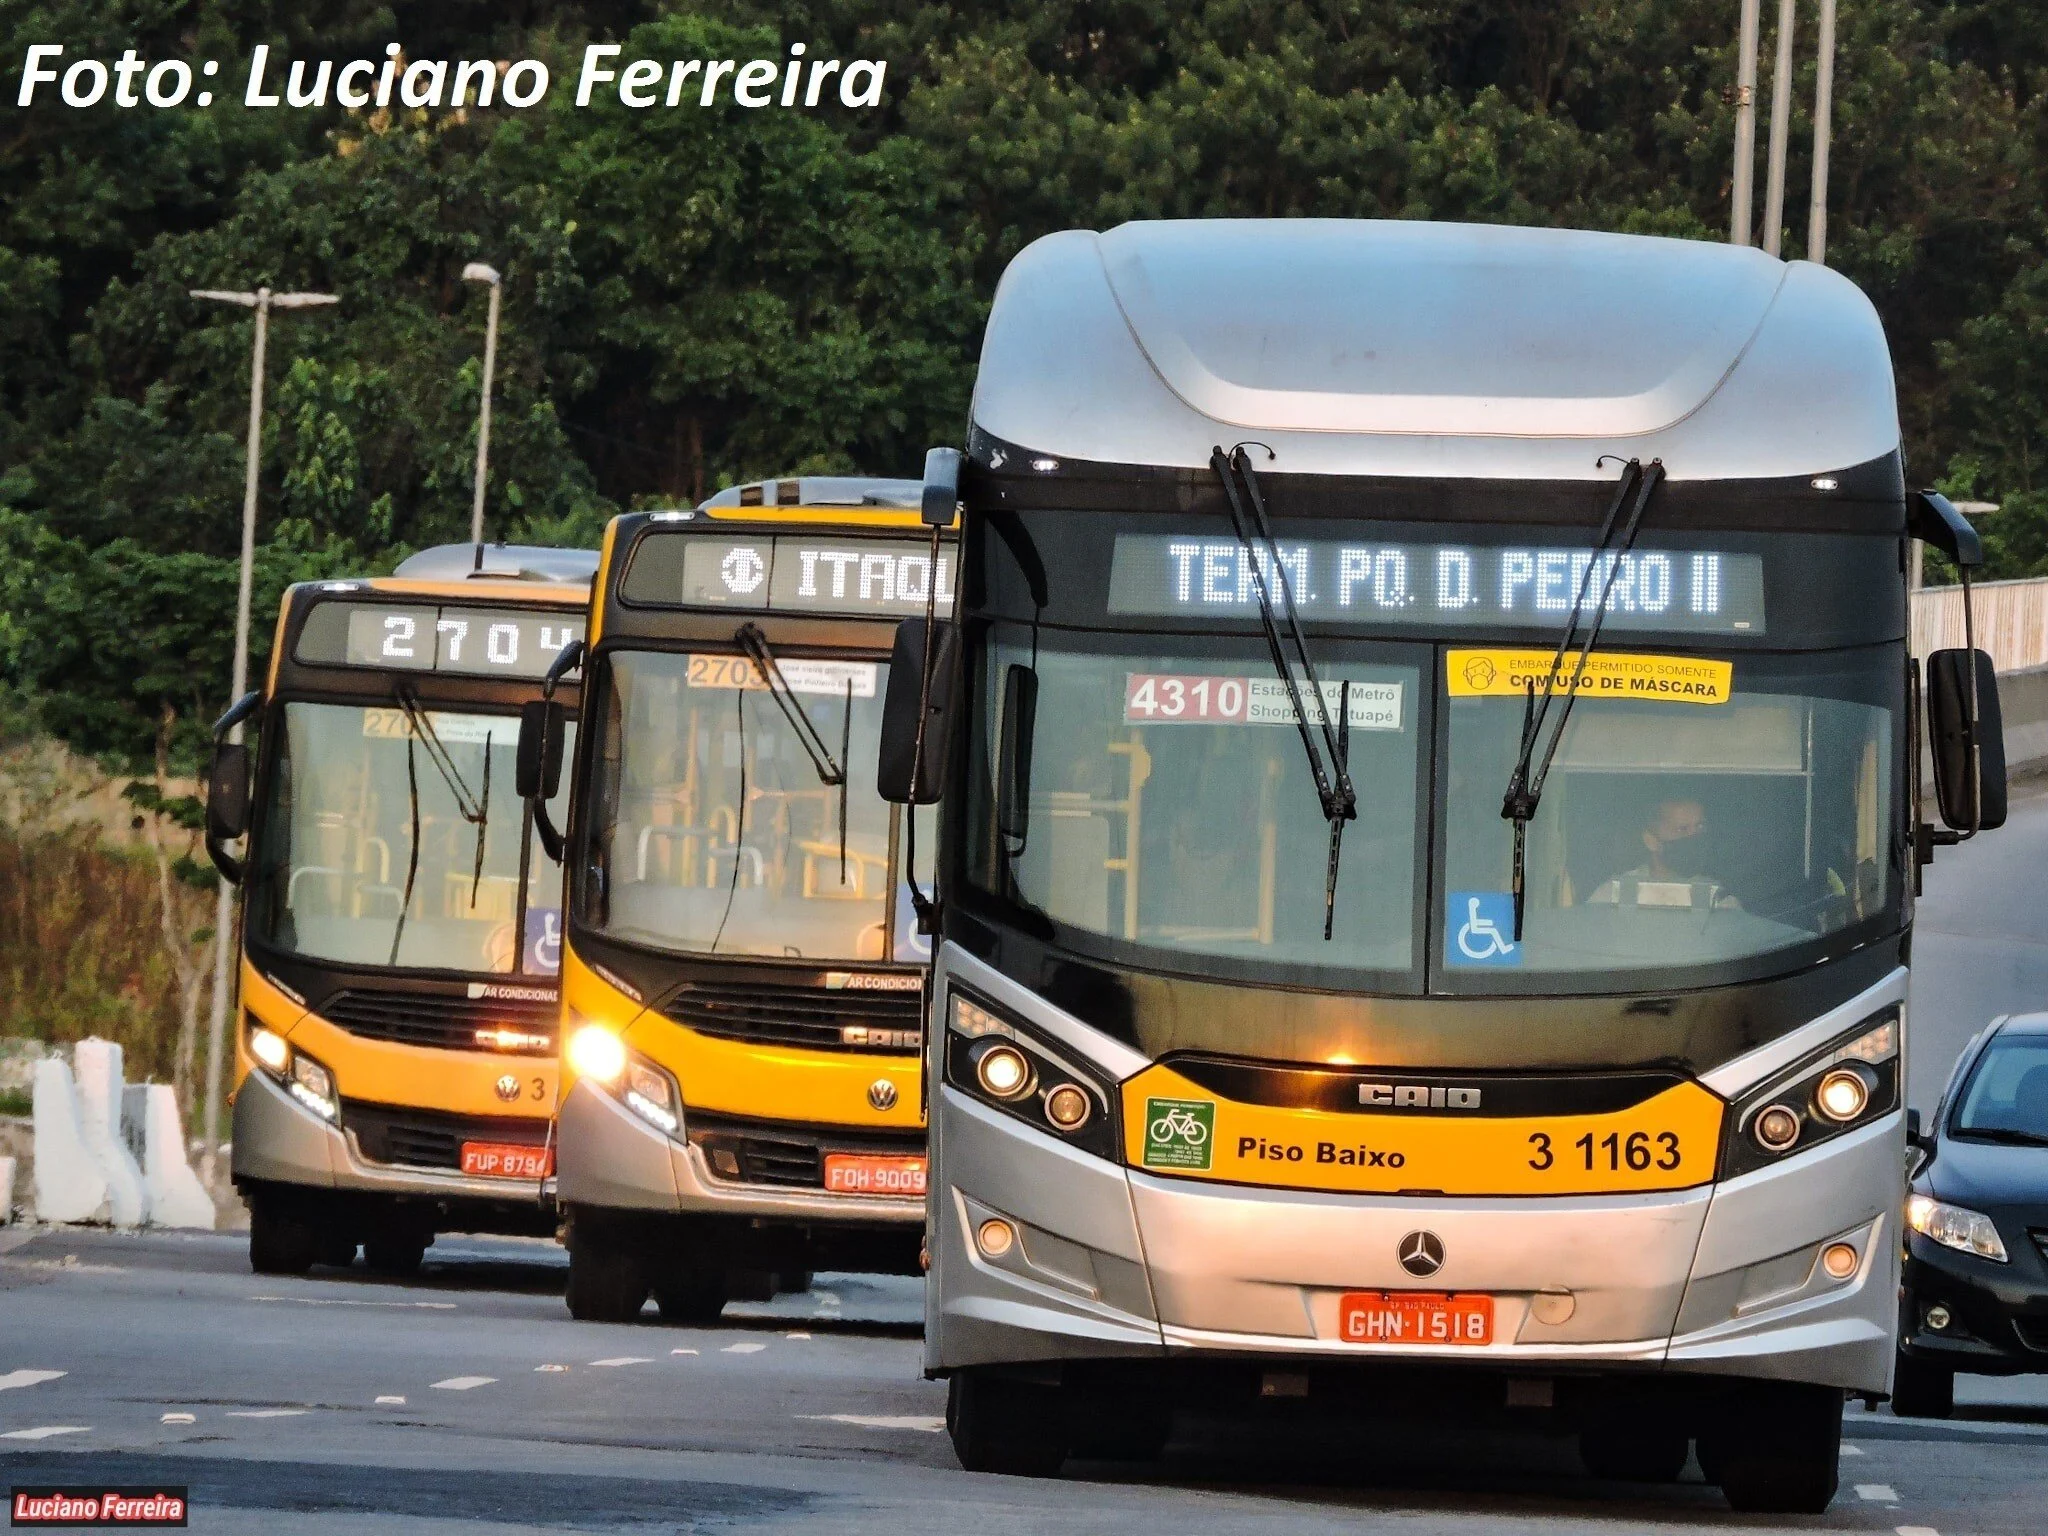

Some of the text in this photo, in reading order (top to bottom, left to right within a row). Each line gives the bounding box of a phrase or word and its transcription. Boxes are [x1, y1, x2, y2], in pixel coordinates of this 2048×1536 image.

[1170, 545, 1719, 612] TERM. PQ. D. PEDRO II
[1509, 659, 1717, 679] EMBARUE PERMITIDO SOMENTE
[1351, 683, 1395, 701] Metrô
[1510, 674, 1550, 688] COM
[1600, 677, 1624, 690] DE
[1630, 676, 1717, 697] MÁSCARA
[1131, 679, 1243, 717] 4310
[1250, 704, 1393, 723] Shoppng Ttuapé
[484, 986, 497, 998] AR
[847, 977, 863, 989] AR
[531, 1077, 546, 1101] 3
[1358, 1083, 1481, 1108] CAIO
[1237, 1136, 1406, 1169] Piso Baixo
[1528, 1131, 1681, 1171] 3 1163
